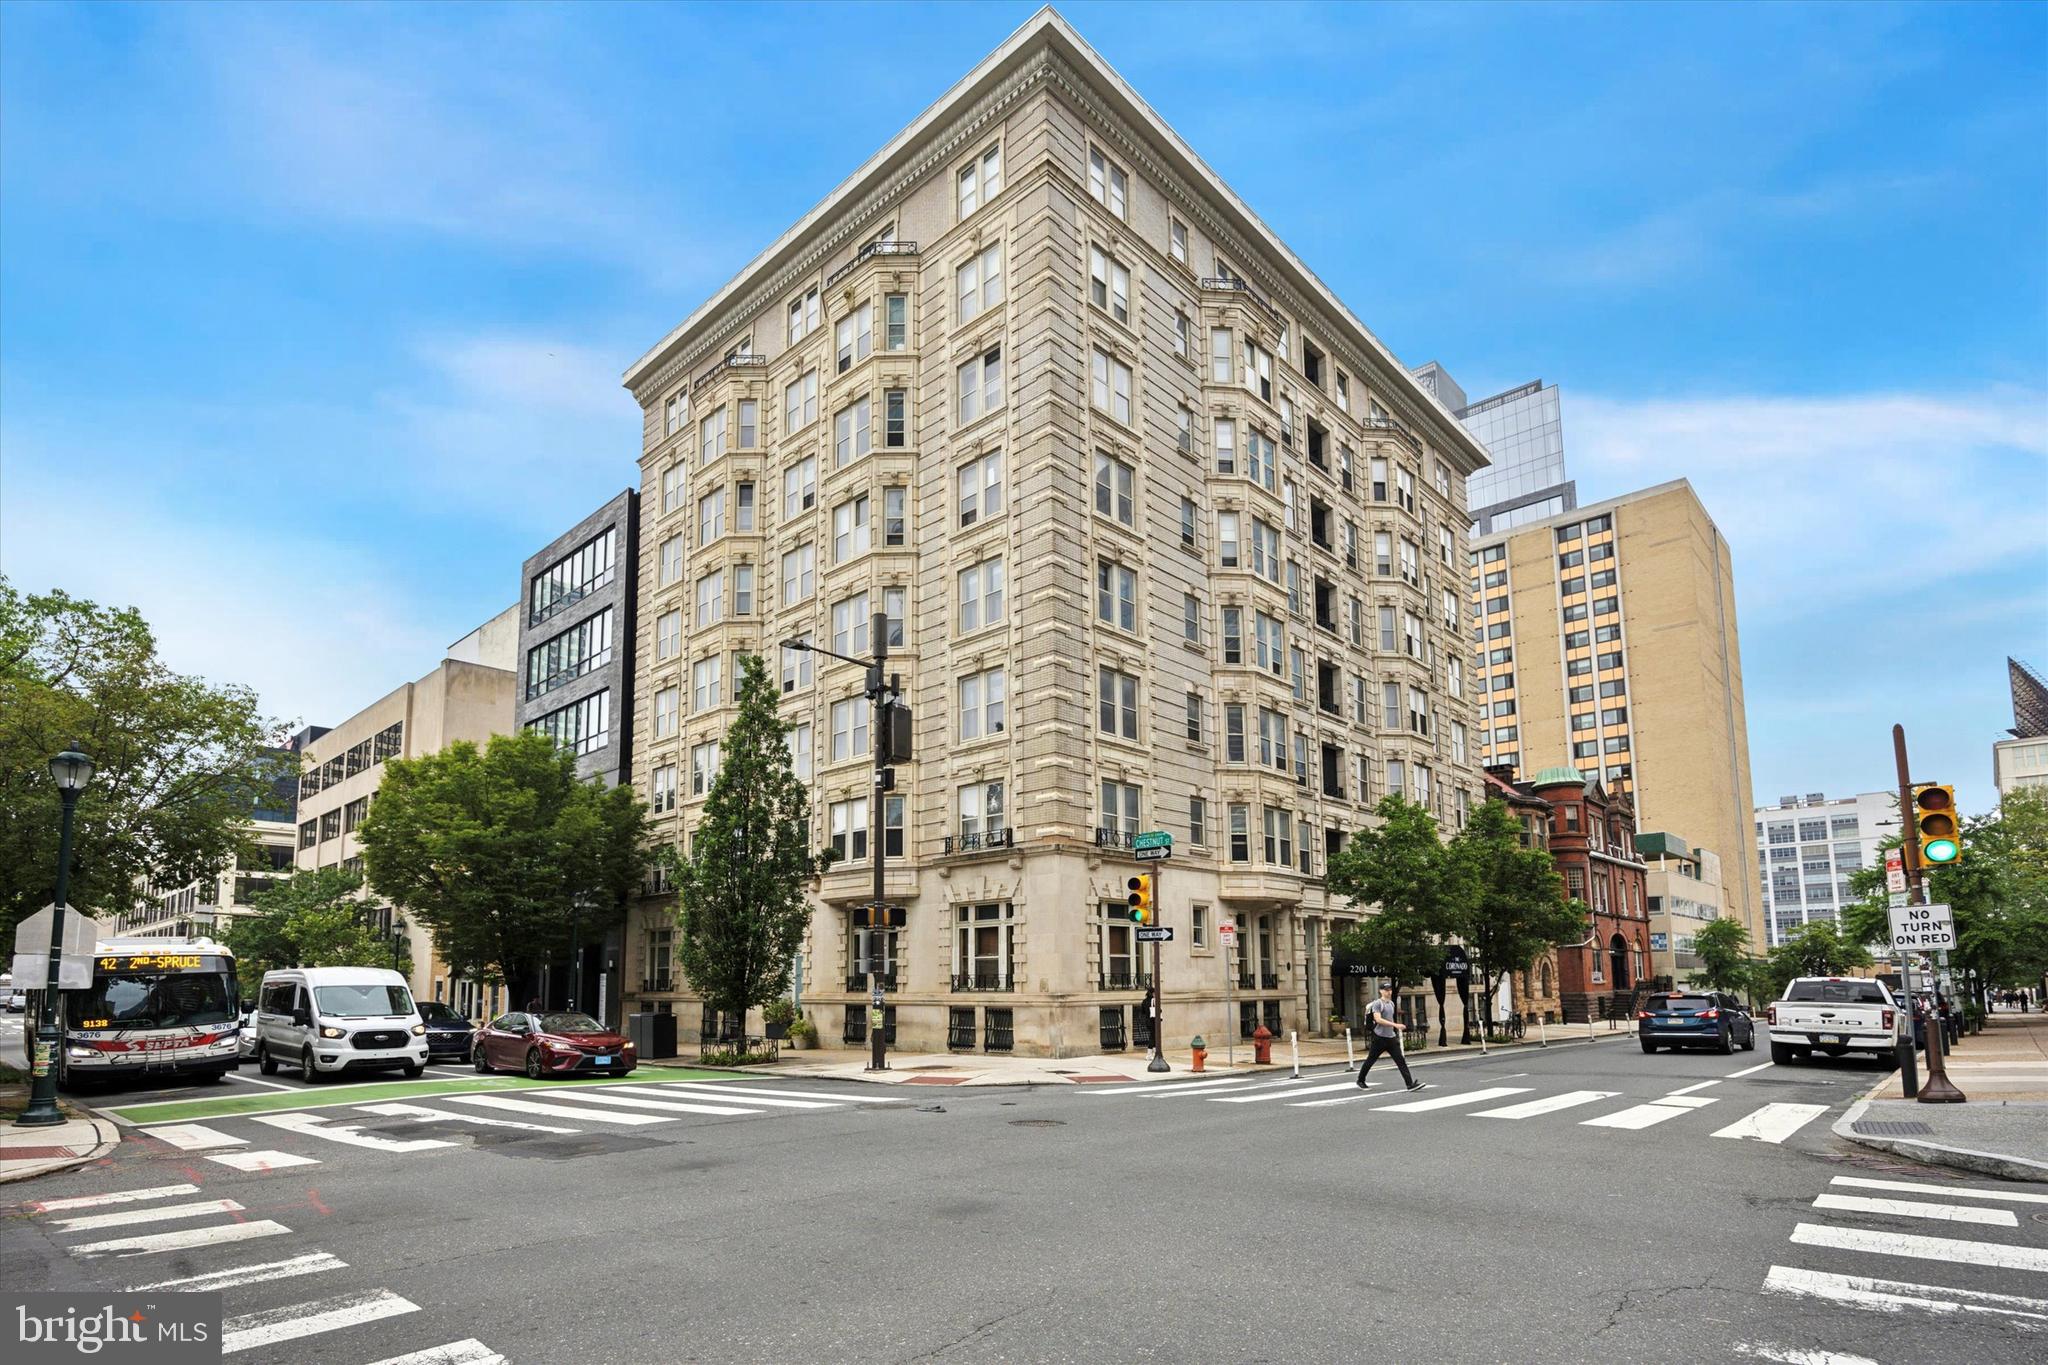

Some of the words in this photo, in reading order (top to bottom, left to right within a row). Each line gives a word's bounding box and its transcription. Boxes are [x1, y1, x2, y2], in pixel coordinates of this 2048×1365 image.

[1136, 836, 1164, 848] CHESTNUT
[1138, 850, 1149, 858] ONE
[1909, 911, 1930, 920] NO
[1901, 921, 1942, 932] TURN
[1896, 935, 1916, 944] ON
[1921, 934, 1951, 944] RED
[100, 957, 117, 970] 42
[1349, 965, 1368, 973] 2201
[83, 1019, 109, 1028] 9138
[211, 1023, 232, 1031] 3676
[77, 1031, 101, 1039] 3676
[144, 1039, 191, 1050] SEPTA
